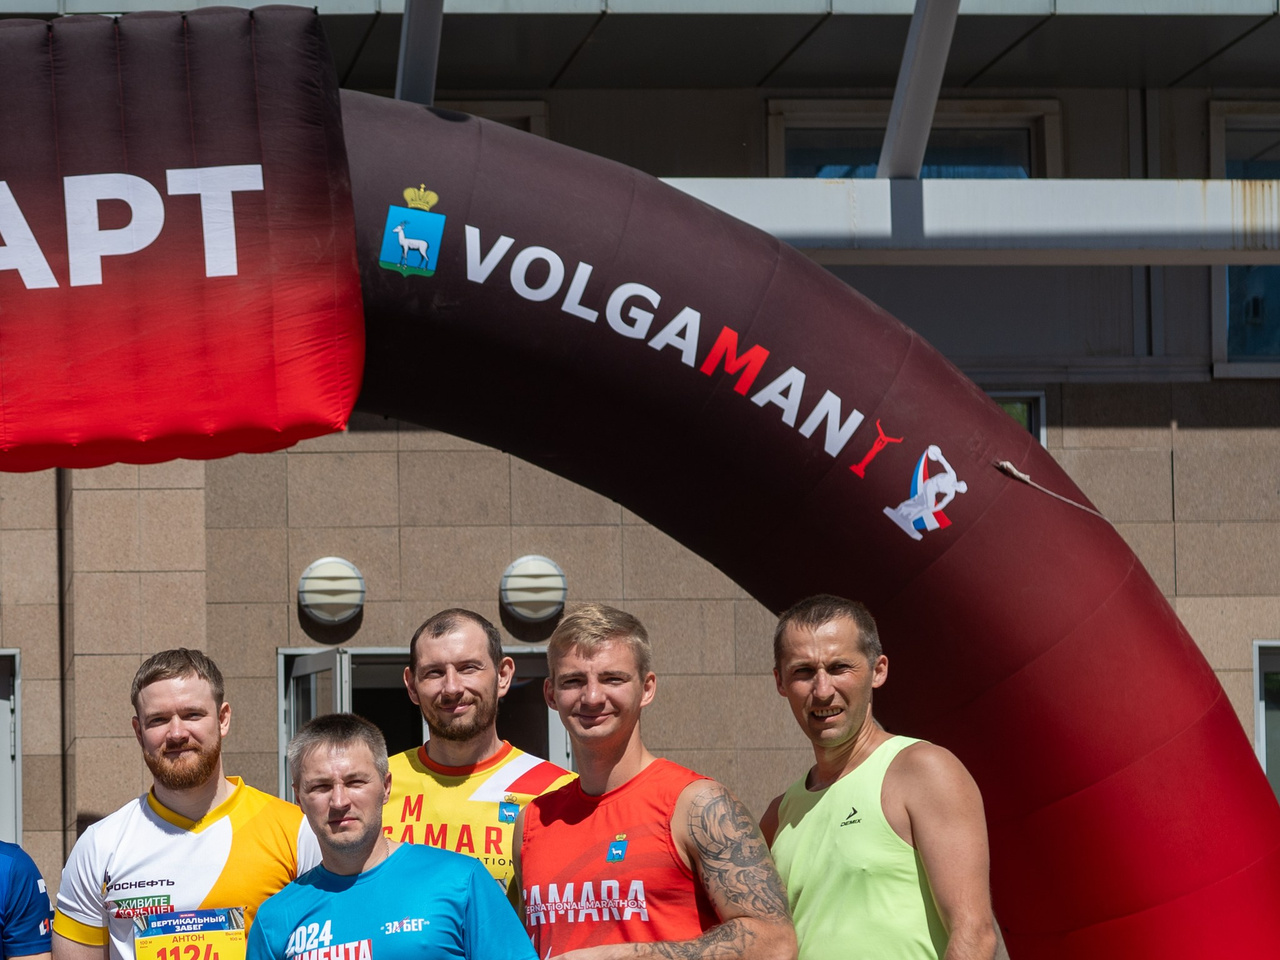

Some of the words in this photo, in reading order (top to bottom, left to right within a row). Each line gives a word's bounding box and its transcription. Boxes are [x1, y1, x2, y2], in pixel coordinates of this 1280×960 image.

[464, 224, 864, 458] VOLGAMAN
[119, 896, 168, 910] ЖИВИТЕ
[526, 901, 584, 915] ERNATIONAL
[586, 899, 646, 909] MARATHON
[151, 914, 226, 928] ВЕРТИКАЛЬНЫЙ
[175, 924, 203, 932] ЗАБЕГ
[172, 934, 205, 943] АНТОН
[286, 920, 333, 957] 2024
